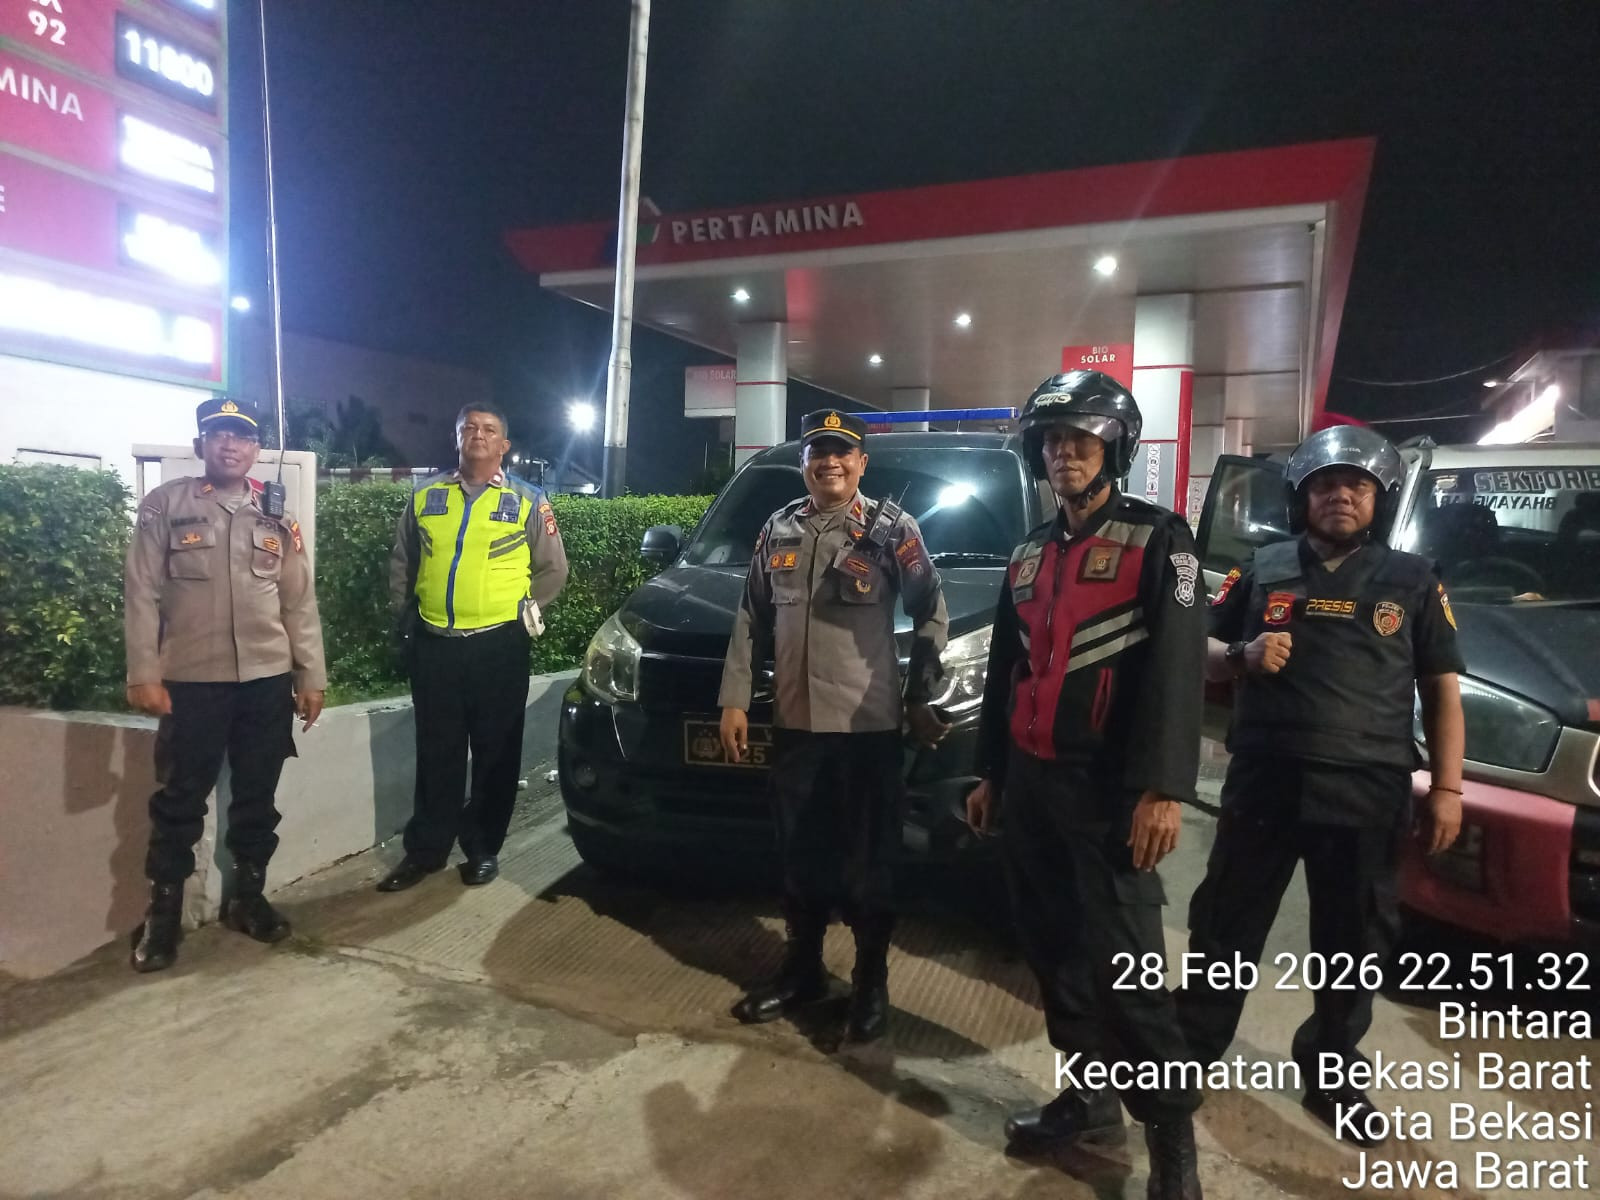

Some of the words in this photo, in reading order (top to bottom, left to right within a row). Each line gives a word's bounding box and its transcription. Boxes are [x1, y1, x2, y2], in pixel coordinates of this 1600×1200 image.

[28, 9, 66, 46] 92
[671, 202, 864, 244] PERTAMINA
[1081, 353, 1116, 364] SOLAR
[1474, 470, 1583, 493] SEKTOR
[1305, 598, 1357, 613] PRESISI
